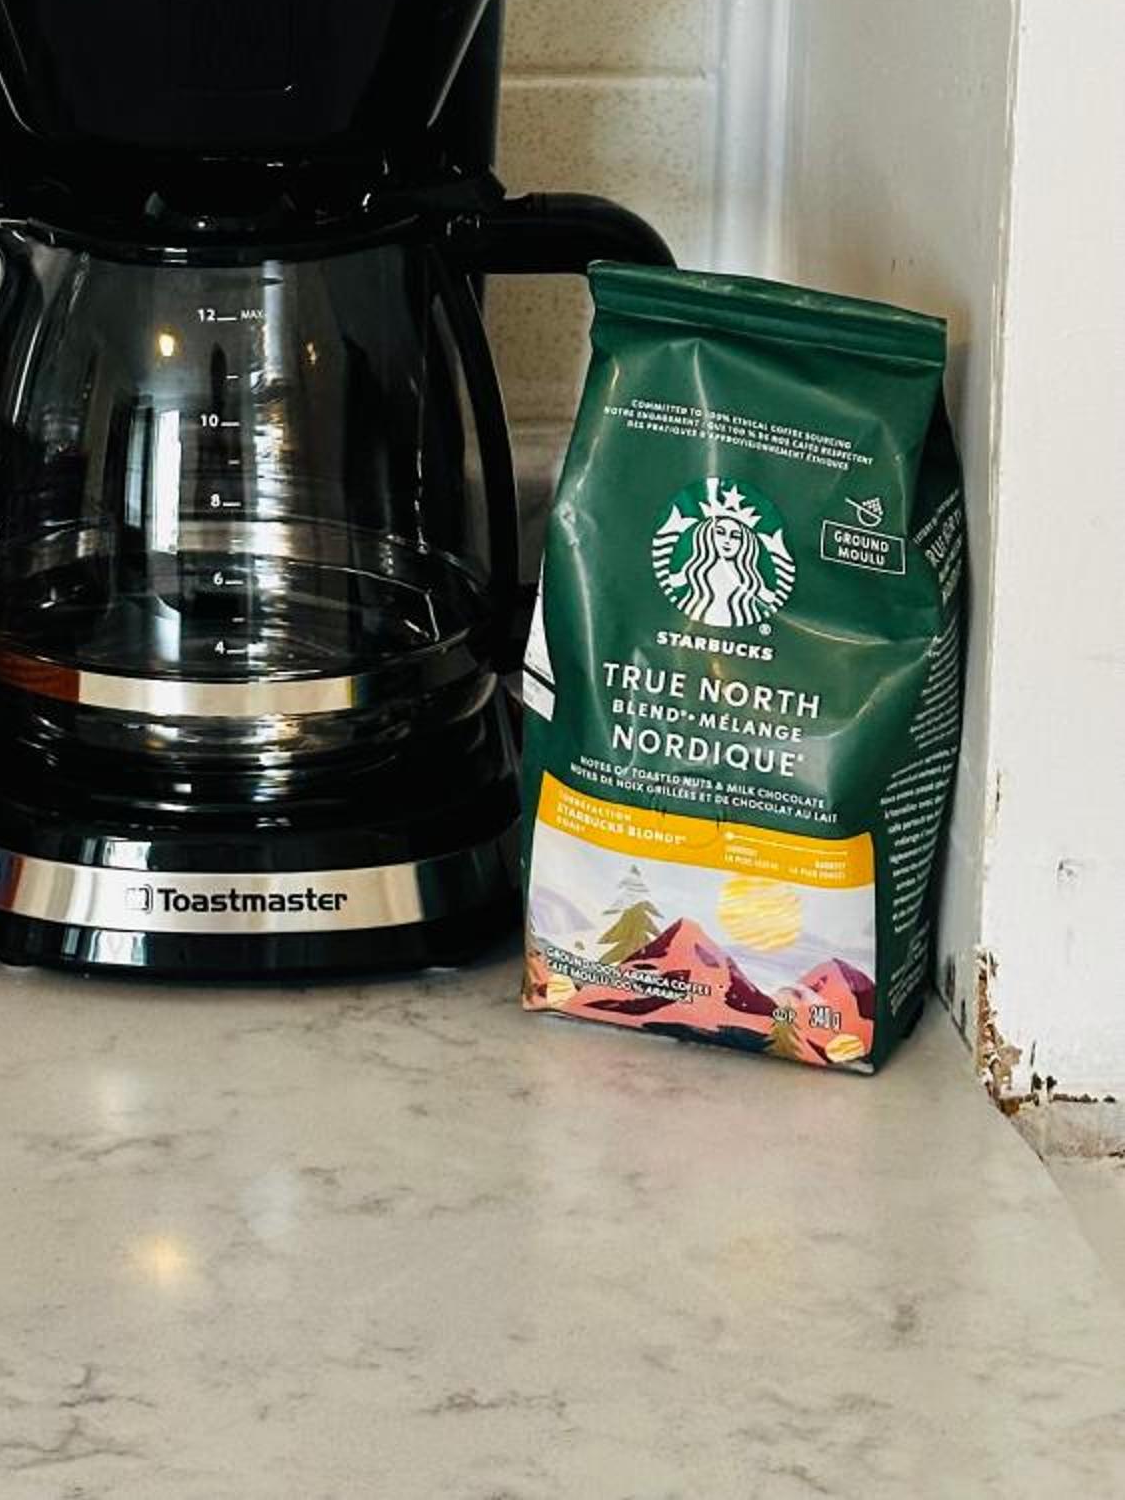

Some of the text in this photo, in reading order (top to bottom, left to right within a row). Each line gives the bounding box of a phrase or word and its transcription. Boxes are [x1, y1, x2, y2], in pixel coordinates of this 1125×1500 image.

[197, 309, 216, 322] 12
[200, 414, 219, 427] 10
[690, 407, 703, 418] TO
[211, 494, 221, 508] 8
[833, 530, 890, 553] GROUND
[838, 546, 885, 566] MOULU
[213, 572, 223, 585] 6
[215, 641, 225, 654] 4
[656, 630, 775, 661] STARBUCKS
[603, 662, 821, 719] TRUE NORTH
[612, 698, 803, 743] BLEND MÉLANGE
[612, 723, 797, 778] NORDIQUE
[580, 755, 612, 773] NOTES
[632, 767, 681, 785] TOASTED
[682, 776, 713, 790] NUTS
[726, 783, 756, 797] MILK
[757, 788, 825, 809] CHOCOLATE
[600, 774, 614, 787] DE
[616, 779, 644, 793] NOIX
[699, 792, 712, 803] ET
[732, 796, 794, 816] CHOCOLAT
[794, 808, 812, 819] AU
[813, 811, 838, 823] LAIT
[157, 888, 348, 913] Toastmaster
